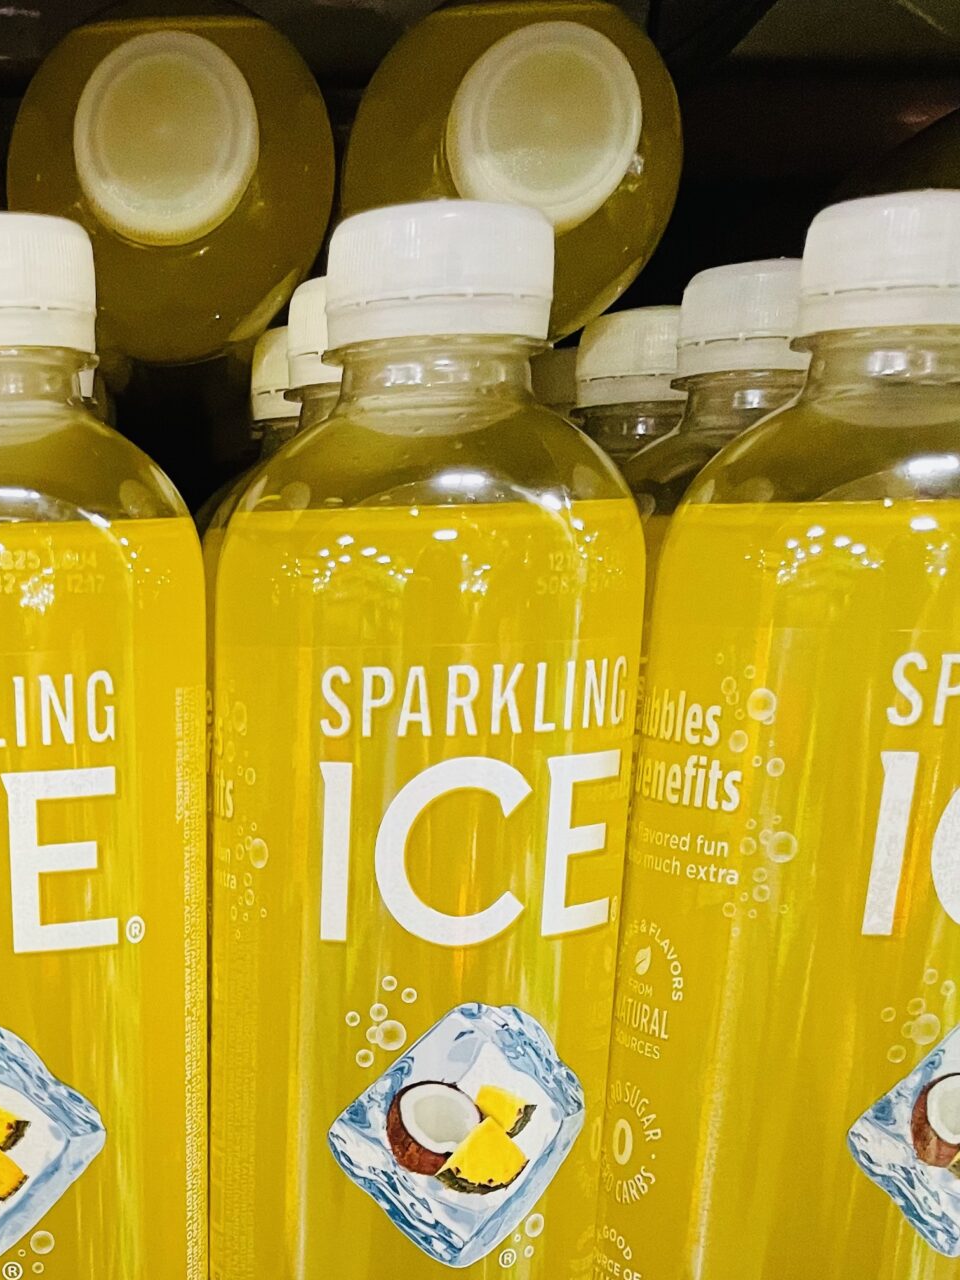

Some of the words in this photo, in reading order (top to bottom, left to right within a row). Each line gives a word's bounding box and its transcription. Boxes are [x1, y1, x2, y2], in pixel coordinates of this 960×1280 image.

[320, 655, 628, 738] SPARKLING
[319, 749, 621, 946] ICE
[696, 834, 729, 858] fun
[644, 854, 680, 876] much
[686, 861, 740, 886] extra
[648, 922, 684, 1002] FLAVORS
[624, 1082, 661, 1142] SUGAR
[613, 1118, 633, 1165] 0
[615, 1166, 656, 1204] CARBS
[603, 1225, 633, 1260] GOOD
